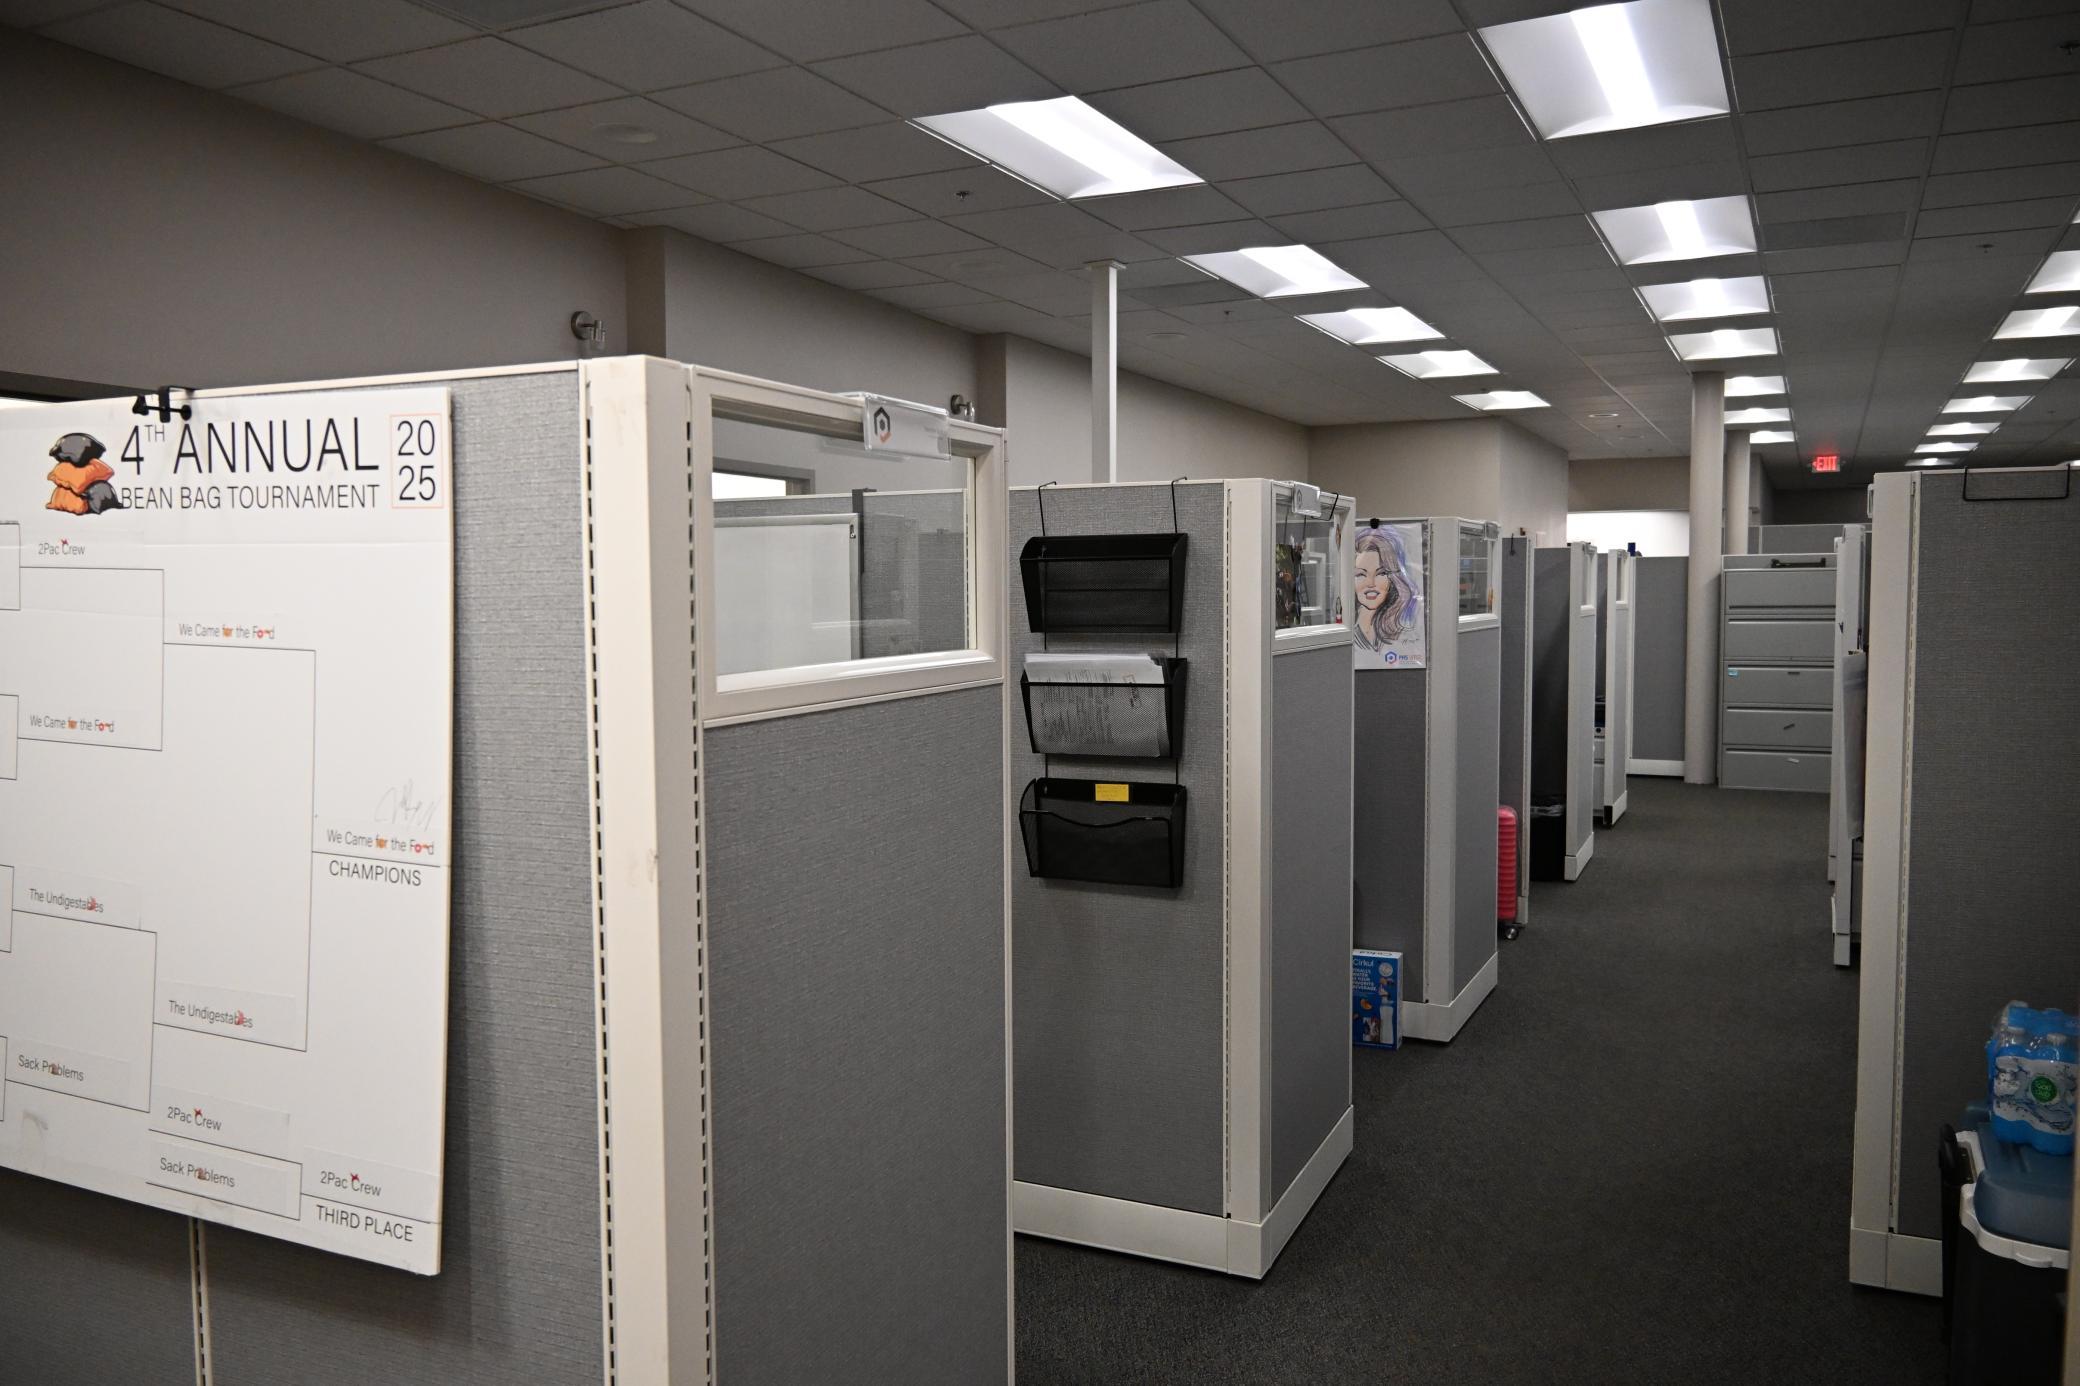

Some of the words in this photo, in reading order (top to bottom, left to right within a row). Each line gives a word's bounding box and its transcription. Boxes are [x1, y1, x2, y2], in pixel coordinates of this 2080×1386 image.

[173, 417, 380, 474] ANNUAL
[397, 419, 435, 456] 20
[1816, 456, 1838, 471] EXIT
[398, 465, 436, 501] 25
[121, 487, 173, 509] BEAN
[180, 486, 221, 509] BAG
[227, 484, 380, 509] TOURNAMENT
[38, 542, 60, 555] 2Pac
[61, 542, 86, 555] Crew
[178, 623, 193, 636] We
[195, 623, 220, 638] Came
[222, 624, 233, 638] fr
[236, 624, 250, 639] the
[252, 625, 275, 640] Fod
[30, 714, 42, 727] We
[43, 715, 66, 729] Came
[80, 718, 92, 731] the
[95, 719, 114, 732] Fod
[327, 828, 342, 843] We
[345, 831, 373, 848] Came
[375, 833, 388, 849] fr
[391, 837, 407, 852] the
[410, 839, 434, 855] Fod
[329, 860, 421, 886] CHAMPIONS
[29, 888, 44, 902] The
[46, 891, 104, 913] Undigestabes
[169, 1000, 185, 1015] The
[188, 1004, 253, 1029] Undigestabes
[18, 1054, 39, 1071] Sack
[42, 1060, 84, 1081] Prblems
[168, 1106, 192, 1123] 2Pac
[194, 1112, 222, 1131] Crew
[160, 1157, 185, 1175] Sack
[187, 1163, 235, 1188] Prblems
[320, 1170, 348, 1189] 2Pac
[351, 1178, 382, 1196] Crew
[317, 1204, 360, 1229] THIRD
[364, 1216, 413, 1242] PLACE
